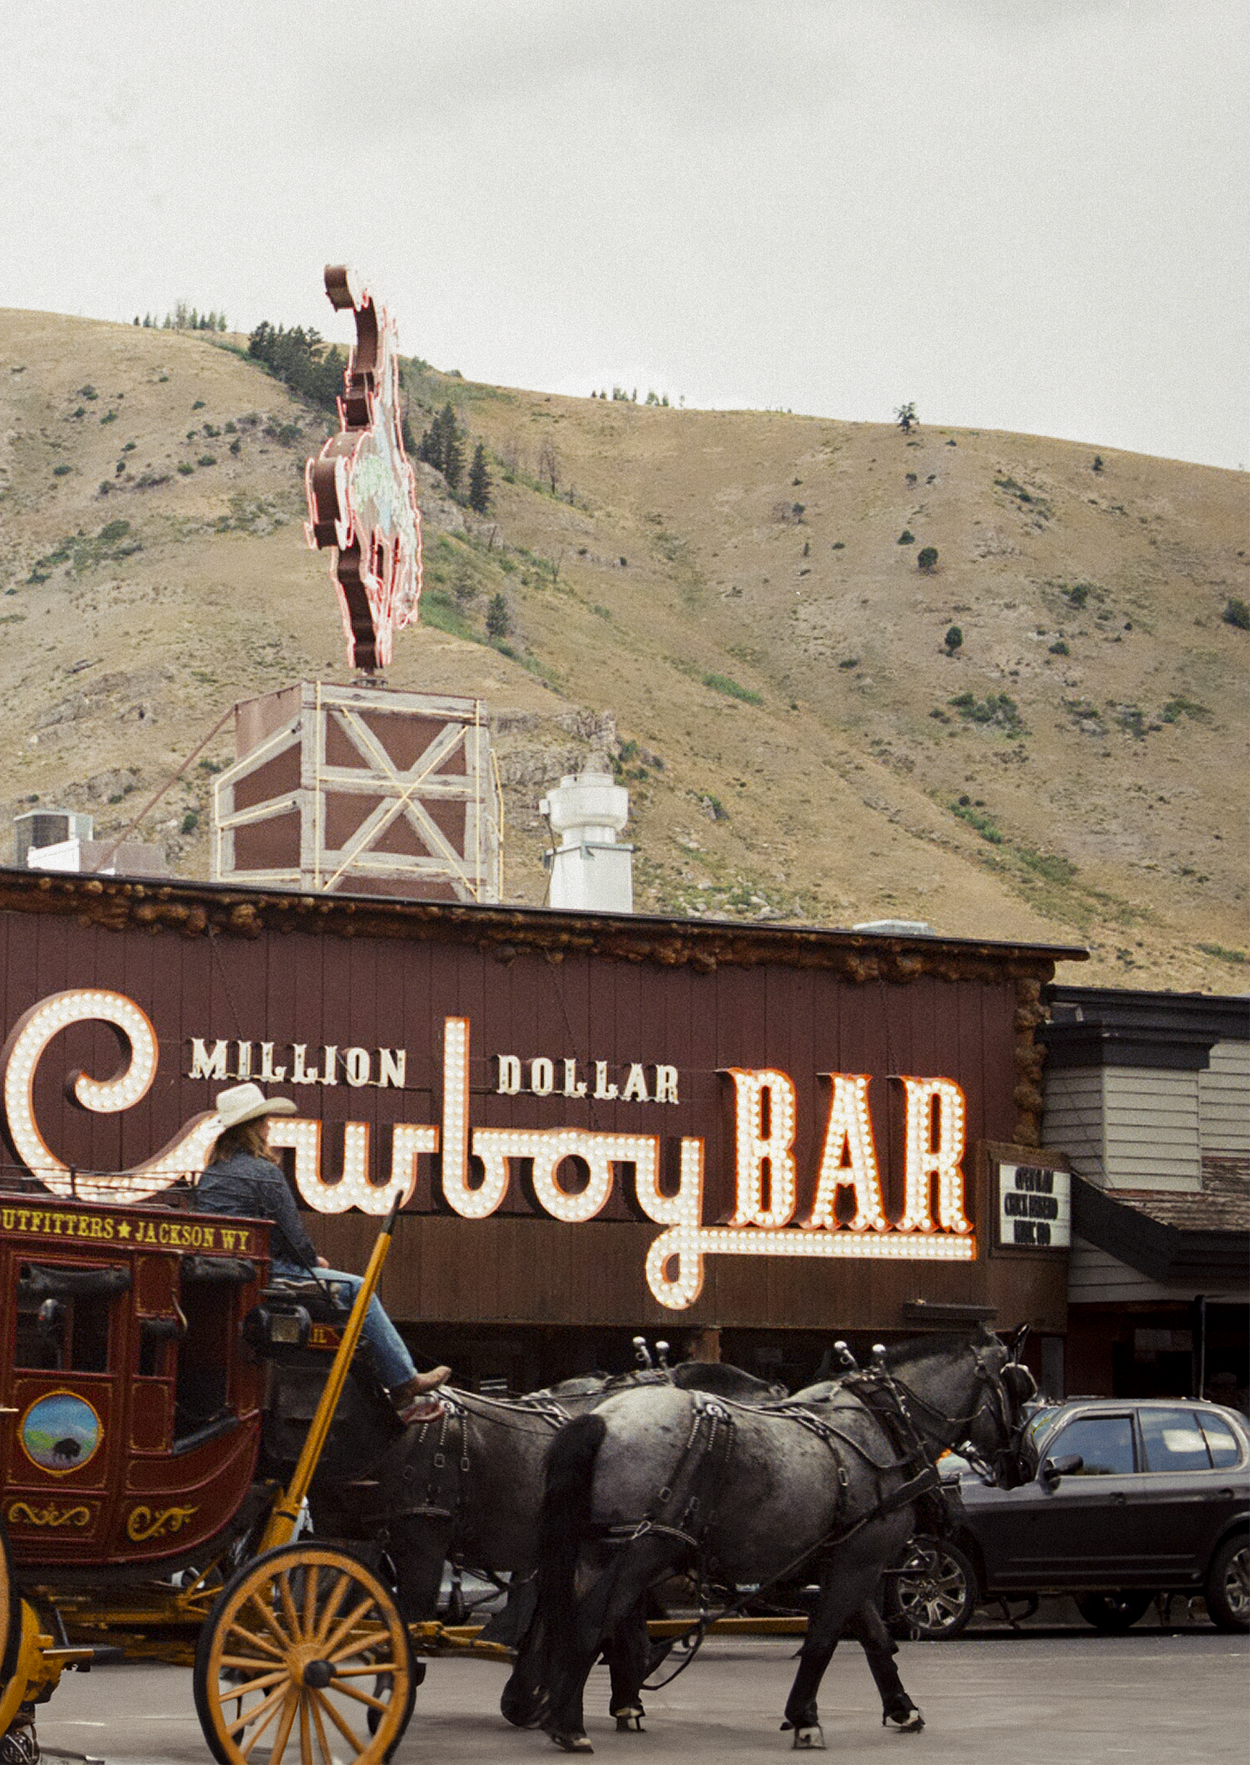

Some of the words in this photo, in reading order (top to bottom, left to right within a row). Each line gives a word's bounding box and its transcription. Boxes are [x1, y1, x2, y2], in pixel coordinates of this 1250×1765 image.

[190, 1037, 407, 1088] MILLION
[496, 1054, 679, 1105] DOLLAR
[2, 987, 706, 1311] Cwboy
[726, 1067, 974, 1235] BAR
[135, 1221, 216, 1248] JACKSON
[220, 1229, 250, 1251] WY
